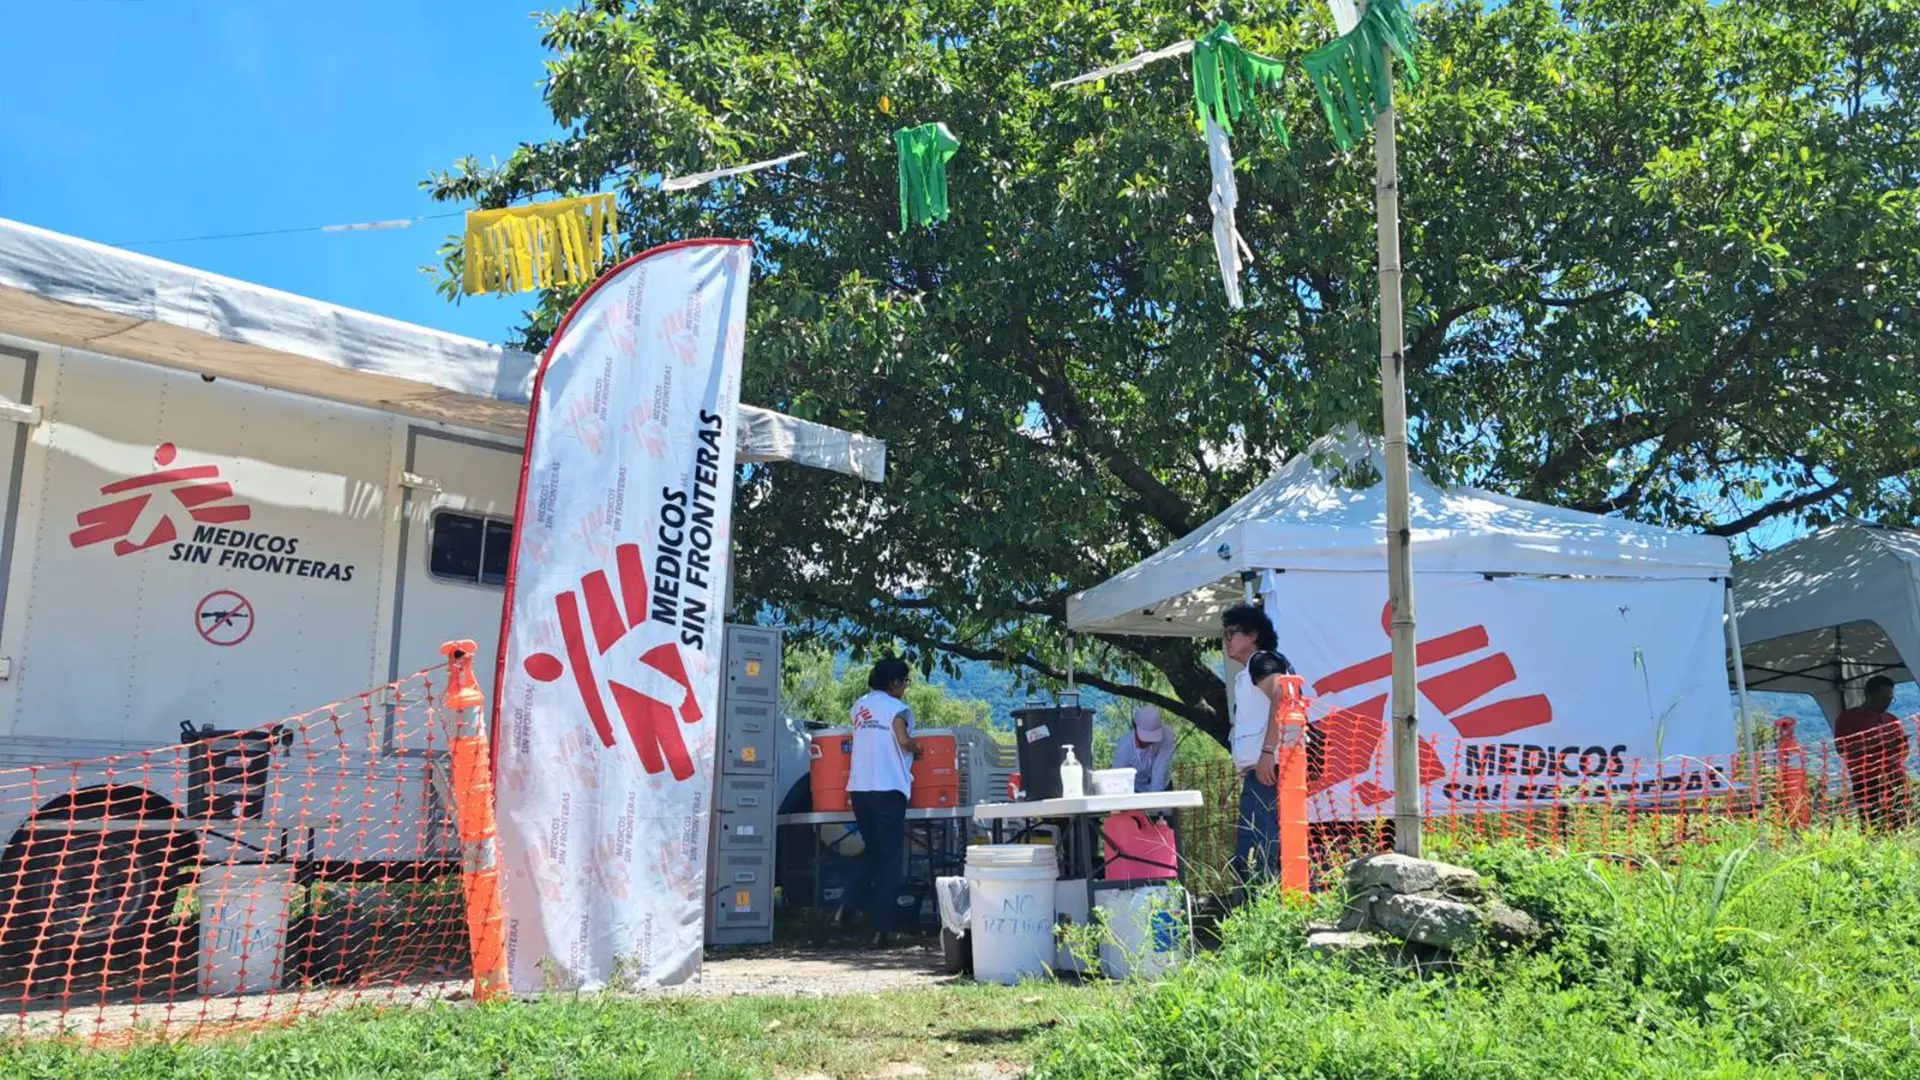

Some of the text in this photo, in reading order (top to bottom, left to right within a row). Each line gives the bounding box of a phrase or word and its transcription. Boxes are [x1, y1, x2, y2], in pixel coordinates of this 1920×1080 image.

[192, 525, 298, 555] MEDICOS
[651, 486, 688, 626] MEDICOS
[681, 409, 723, 651] SIN FRONTERAS
[169, 543, 354, 582] SIN FRONTERAS
[1466, 744, 1627, 777] MEDICOS
[549, 817, 560, 859] MEDICOS
[557, 792, 571, 865] SIN FRONTERAS
[616, 816, 626, 856] MEDICOS
[623, 790, 637, 863] SIN FRONTERAS
[689, 791, 702, 861] SIN FRONTERAS
